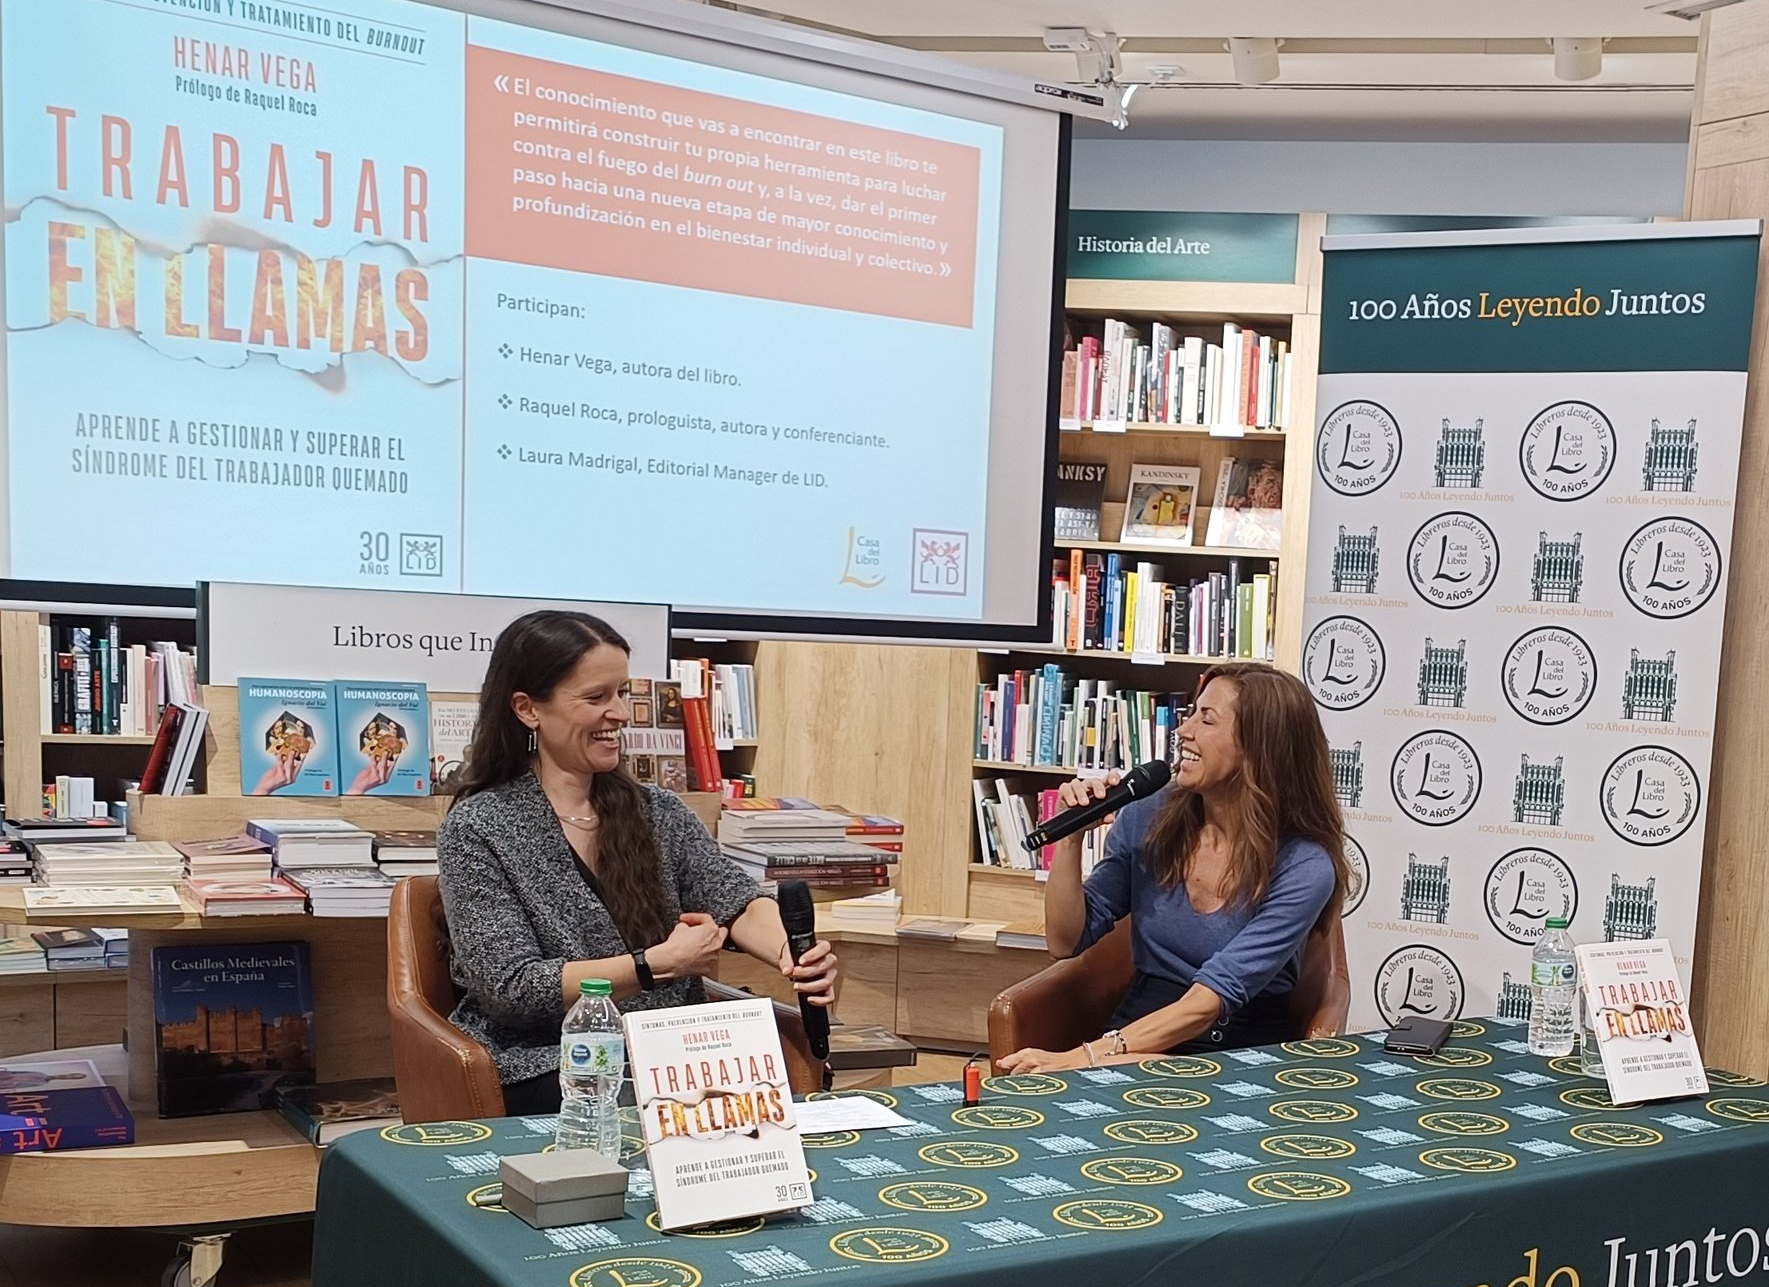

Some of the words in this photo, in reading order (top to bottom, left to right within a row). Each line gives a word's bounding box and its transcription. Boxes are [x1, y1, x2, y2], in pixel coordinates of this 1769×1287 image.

[240, 1, 331, 37] TRATAMIENTO
[337, 23, 360, 42] DEL
[366, 28, 426, 55] BURNOUT
[173, 36, 250, 81] HENAR
[261, 52, 318, 93] VEGA
[175, 76, 222, 101] Prólogo
[226, 86, 241, 103] de
[244, 89, 286, 112] Raquel
[288, 97, 318, 117] Roca
[535, 83, 657, 121] conocimiento
[662, 109, 694, 128] que
[697, 117, 725, 134] vas
[730, 123, 740, 137] a
[744, 124, 821, 153] encontrar
[826, 139, 845, 157] en
[849, 143, 881, 164] este
[885, 145, 918, 171] libro
[922, 158, 937, 175] te
[513, 110, 598, 138] permitirá
[602, 126, 680, 153] construir
[685, 140, 702, 158] tu
[708, 143, 759, 171] propia
[764, 153, 861, 187] herramienta
[865, 173, 897, 195] para
[901, 180, 947, 202] luchar
[46, 105, 429, 243] TRABAJAR
[513, 139, 571, 162] contra
[576, 147, 594, 165] el
[598, 150, 648, 177] fuego
[652, 158, 679, 179] del
[683, 166, 722, 188] burn
[726, 175, 753, 194] out
[775, 185, 785, 199] a
[789, 182, 804, 203] la
[807, 191, 836, 210] vez,
[841, 194, 866, 214] dar
[871, 199, 884, 218] el
[888, 203, 937, 227] primer
[513, 167, 556, 189] paso
[561, 171, 608, 197] hacia
[613, 183, 646, 202] una
[650, 189, 701, 211] nueva
[706, 198, 752, 222] etapa
[756, 203, 777, 223] de
[781, 213, 831, 236] mayor
[835, 219, 935, 253] conocimiento
[940, 239, 948, 256] y
[513, 195, 646, 232] profundización
[650, 217, 672, 234] en
[676, 218, 691, 238] el
[697, 223, 772, 251] bienestar
[776, 235, 851, 264] individual
[855, 252, 864, 267] y
[1078, 236, 1144, 254] Historia
[1146, 237, 1172, 254] del
[1173, 238, 1210, 255] Arte
[48, 221, 136, 330] EN
[165, 243, 429, 363] LLAMAS
[497, 293, 586, 321] Participan:
[1349, 301, 1396, 320] 100
[1401, 294, 1471, 319] Años
[1478, 288, 1600, 327] Leyendo
[1605, 289, 1705, 316] Juntos
[520, 346, 570, 367] Henar
[575, 353, 617, 376] Vega,
[622, 359, 673, 379] autora
[677, 363, 700, 383] del
[704, 367, 742, 388] libro.
[520, 397, 576, 420] Raquel
[580, 403, 623, 424] Roca,
[627, 407, 717, 434] prologuista,
[720, 418, 768, 438] autora
[772, 425, 781, 441] y
[784, 423, 890, 449] conferenciante.
[76, 413, 161, 443] APRENDE
[168, 420, 180, 444] A
[187, 421, 283, 452] GESTIONAR
[290, 429, 300, 453] Y
[306, 431, 381, 459] SUPERAR
[387, 438, 406, 461] EL
[72, 444, 168, 479] SÍNDROME
[176, 455, 208, 481] DEL
[216, 458, 326, 489] TRABAJADOR
[332, 466, 409, 495] QUEMADO
[519, 447, 564, 466] Laura
[568, 452, 642, 475] Madrigal,
[647, 458, 710, 479] Editorial
[714, 465, 778, 486] Manager
[782, 470, 799, 486] de
[803, 472, 829, 489] LID.
[1140, 469, 1190, 479] KANDINSKY
[1334, 474, 1348, 487] 100
[1350, 474, 1377, 488] AÑOS
[1542, 478, 1558, 492] 100
[1560, 479, 1589, 493] AÑOS
[1606, 496, 1622, 505] 100
[1624, 495, 1649, 505] Años
[1651, 497, 1695, 507] Leyendo
[1698, 497, 1732, 507] Juntos
[359, 531, 390, 562] 30
[856, 536, 880, 548] Casa
[867, 547, 880, 556] del
[1631, 525, 1667, 554] Libreros
[1669, 522, 1696, 538] desde
[1694, 536, 1711, 557] 1923
[855, 553, 880, 566] Libro
[1664, 549, 1685, 558] Casa
[359, 562, 390, 576] AÑOS
[919, 563, 960, 586] LID
[1662, 564, 1685, 572] Libro
[1642, 595, 1659, 609] 100
[1661, 597, 1691, 610] AÑOS
[333, 625, 413, 649] Libros
[419, 634, 463, 657] que
[249, 688, 327, 700] HUMANOSCOPIA
[344, 690, 419, 701] HUMANOSCOPIA
[1611, 753, 1647, 781] Libreros
[1648, 751, 1675, 768] desde
[1673, 765, 1690, 787] 1923
[1644, 778, 1665, 787] Casa
[1642, 792, 1664, 801] Libro
[1623, 821, 1639, 835] 100
[1641, 825, 1671, 837] AÑOS
[171, 958, 225, 971] Castillos
[227, 956, 295, 969] Medievales
[203, 974, 219, 983] en
[222, 971, 265, 984] España
[1599, 980, 1678, 1006] TRABAJAR
[1606, 1013, 1627, 1038] EN
[1630, 1006, 1686, 1035] LLAMAS
[682, 1031, 709, 1045] HENAR
[710, 1029, 731, 1042] VEGA
[650, 1054, 776, 1094] TRABAJAR
[657, 1102, 688, 1137] EN
[695, 1090, 785, 1133] LLAMAS
[13, 1128, 63, 1150] Art
[675, 1162, 702, 1175] APRENDE
[710, 1156, 744, 1169] GESTIONAR
[750, 1151, 777, 1163] SUPERAR
[778, 1150, 785, 1159] EL
[709, 1172, 721, 1182] DEL
[721, 1165, 760, 1180] TRABAJADOR
[761, 1161, 789, 1174] QUEMADO
[775, 1185, 788, 1198] 30
[1603, 1226, 1769, 1287] Junto
